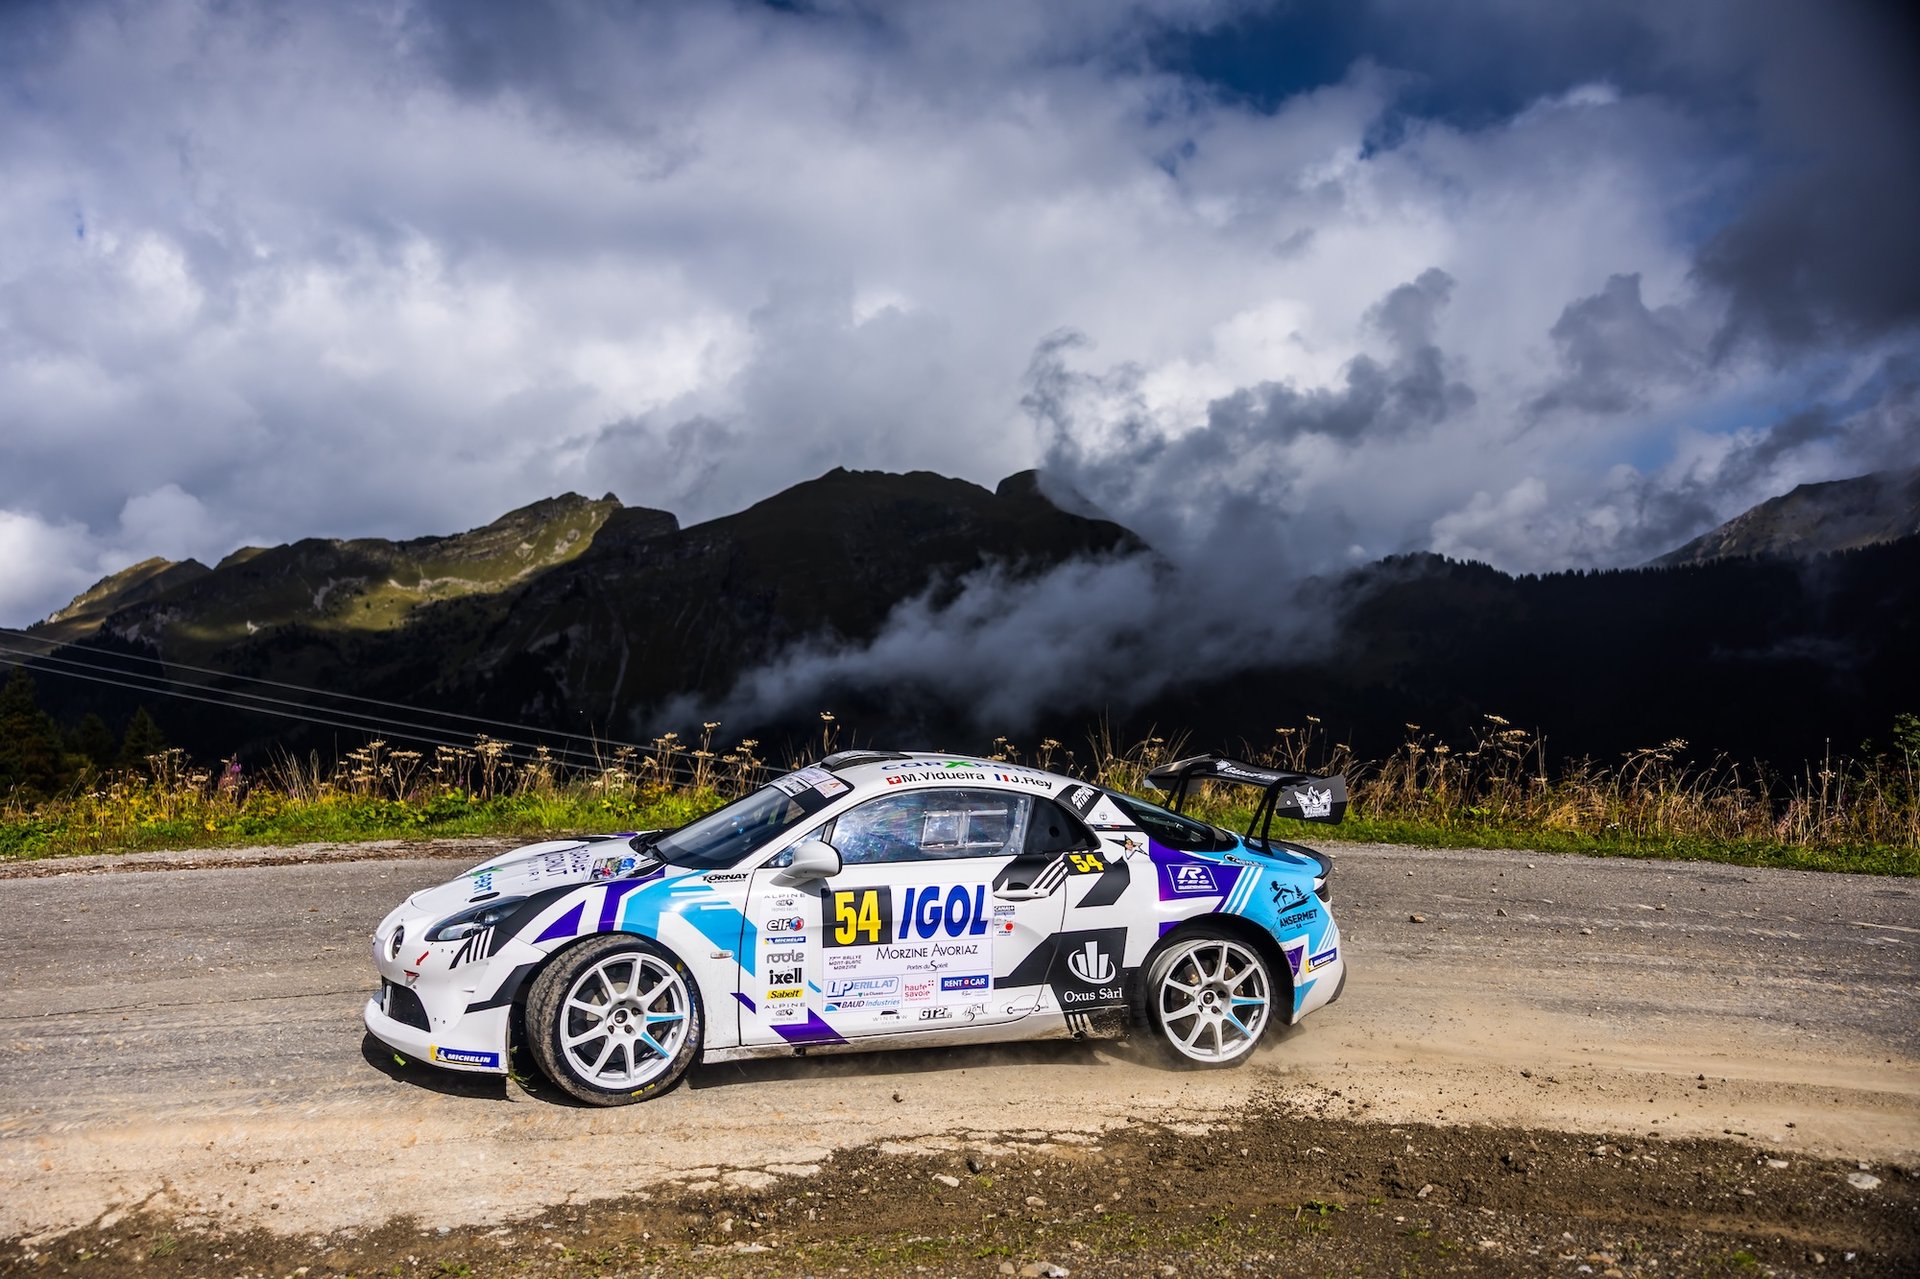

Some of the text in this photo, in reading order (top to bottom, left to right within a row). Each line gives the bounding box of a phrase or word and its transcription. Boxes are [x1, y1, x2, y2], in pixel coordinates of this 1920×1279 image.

[901, 771, 985, 784] M.Vidueira
[1010, 774, 1053, 790] J.Rey
[1069, 854, 1104, 873] 54
[702, 873, 749, 883] TORNAY
[835, 890, 882, 945] 54
[898, 885, 988, 939] IGOL
[1280, 909, 1318, 928] ANSERMET
[876, 943, 978, 960] MORZINE AVORIAZ
[769, 967, 803, 985] ixell
[944, 979, 963, 988] RENT
[970, 978, 986, 986] CAR
[905, 983, 928, 991] haute
[905, 990, 930, 998] savoie
[770, 990, 800, 999] Sabelt
[1064, 987, 1123, 1003] Oxus Sàrl
[841, 1000, 865, 1009] BAUD
[865, 998, 900, 1007] Industries
[447, 1053, 491, 1063] MICHELIN
